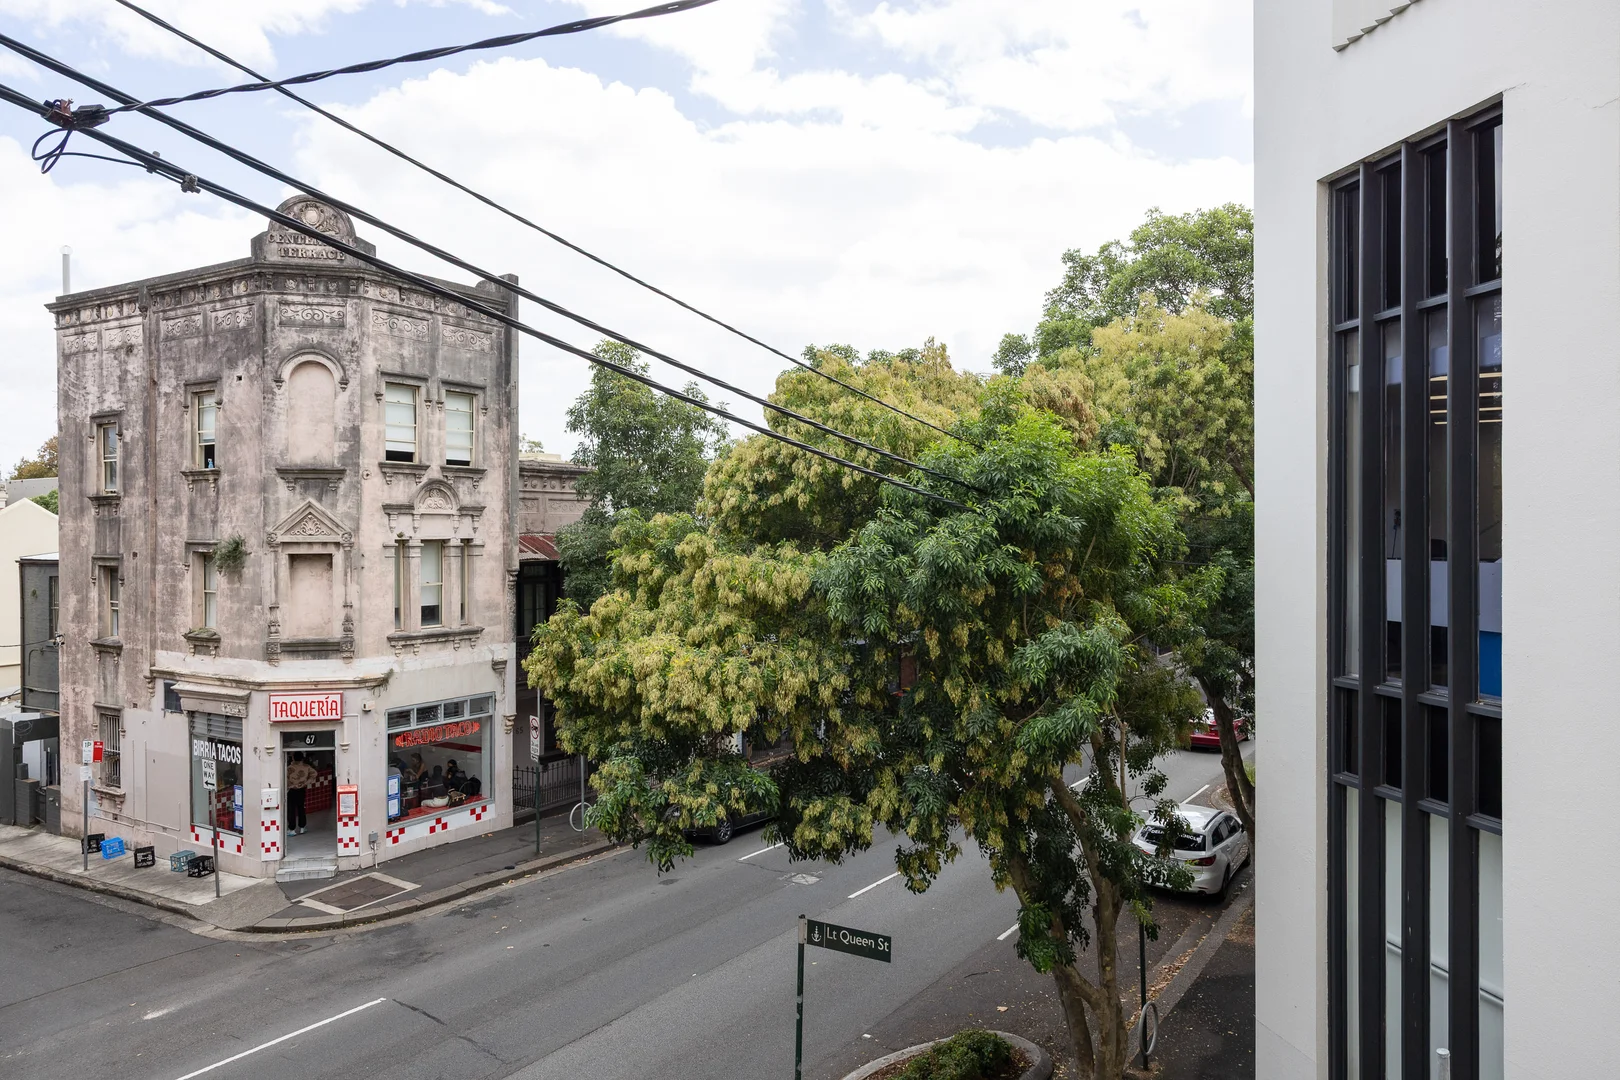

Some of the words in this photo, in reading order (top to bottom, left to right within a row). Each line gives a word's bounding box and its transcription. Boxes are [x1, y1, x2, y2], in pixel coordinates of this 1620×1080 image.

[268, 232, 356, 248] CENTENAL
[278, 247, 345, 260] TERRACE
[272, 696, 339, 719] TAQUERÍA
[305, 735, 315, 744] 67
[404, 728, 443, 746] RADIO
[443, 720, 471, 739] TACO
[193, 739, 217, 760] BIRRIA
[217, 743, 241, 765] TACOS
[204, 761, 214, 770] ONE
[827, 927, 837, 940] Lt
[840, 930, 875, 948] Queen
[878, 938, 889, 951] St
